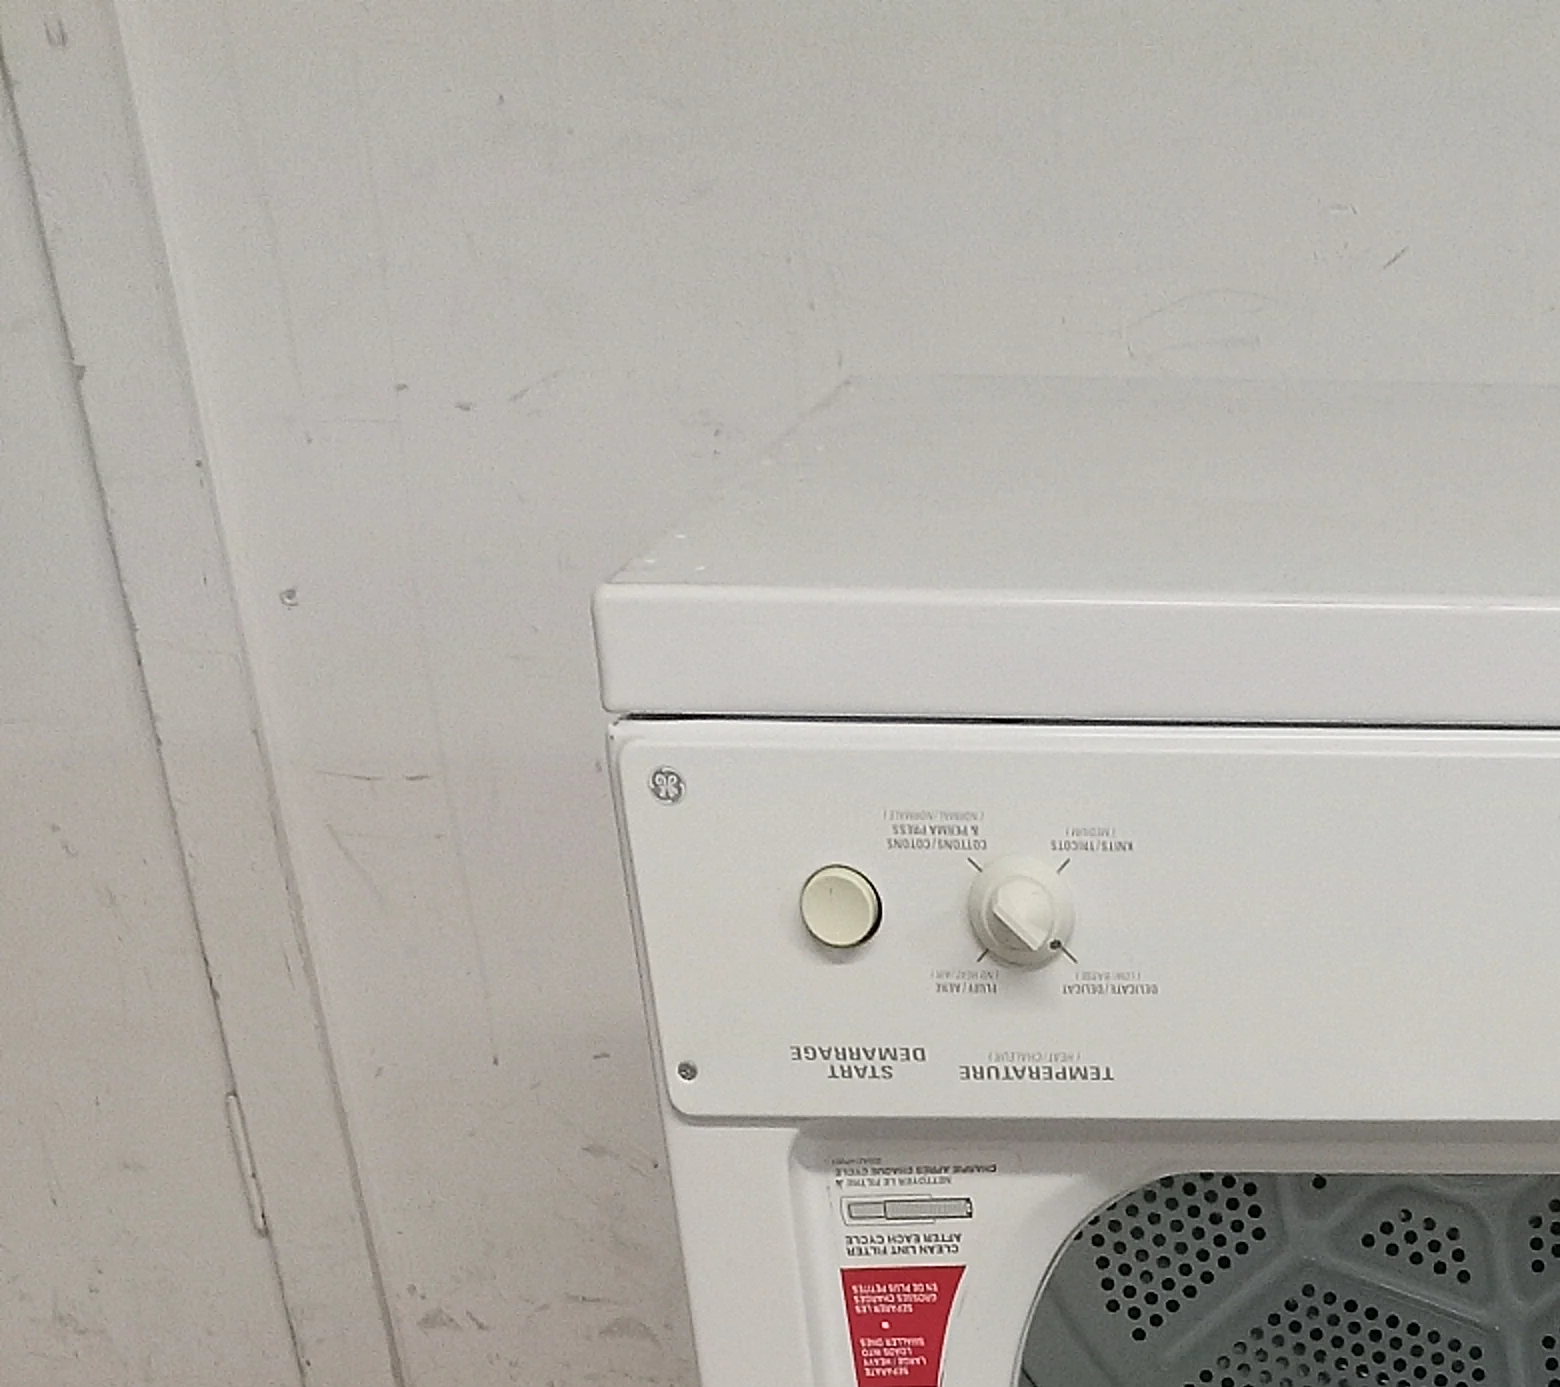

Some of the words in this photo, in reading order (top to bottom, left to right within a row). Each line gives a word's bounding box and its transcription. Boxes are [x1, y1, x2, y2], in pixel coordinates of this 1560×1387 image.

[892, 824, 927, 835] PRESS
[928, 824, 968, 836] PERMA
[969, 824, 979, 836] &
[886, 838, 987, 850] COTTONS/COTONS
[790, 1046, 926, 1062] DEMARRAGE
[827, 1064, 893, 1080] START
[959, 1064, 1114, 1081] TEMPERATURE
[835, 1167, 869, 1177] CYCLE
[846, 1178, 880, 1188] FILTRE
[884, 1178, 896, 1186] LE
[898, 1176, 952, 1186] NETTOYER
[844, 1235, 884, 1245] CYCLE
[887, 1234, 920, 1244] EACH
[923, 1233, 962, 1243] AFTER
[846, 1246, 887, 1256] FILTER
[890, 1245, 917, 1255] LINT
[920, 1244, 959, 1254] CLEAN
[852, 1284, 886, 1294] PETITES
[888, 1284, 910, 1292] PLUS
[926, 1282, 938, 1292] EN
[860, 1338, 882, 1346] ONES
[886, 1337, 924, 1346] SMALLER
[862, 1348, 881, 1356] INTO
[884, 1347, 912, 1356] LOADS
[898, 1356, 926, 1365] LARGE
[864, 1367, 909, 1376] SEPARATE
